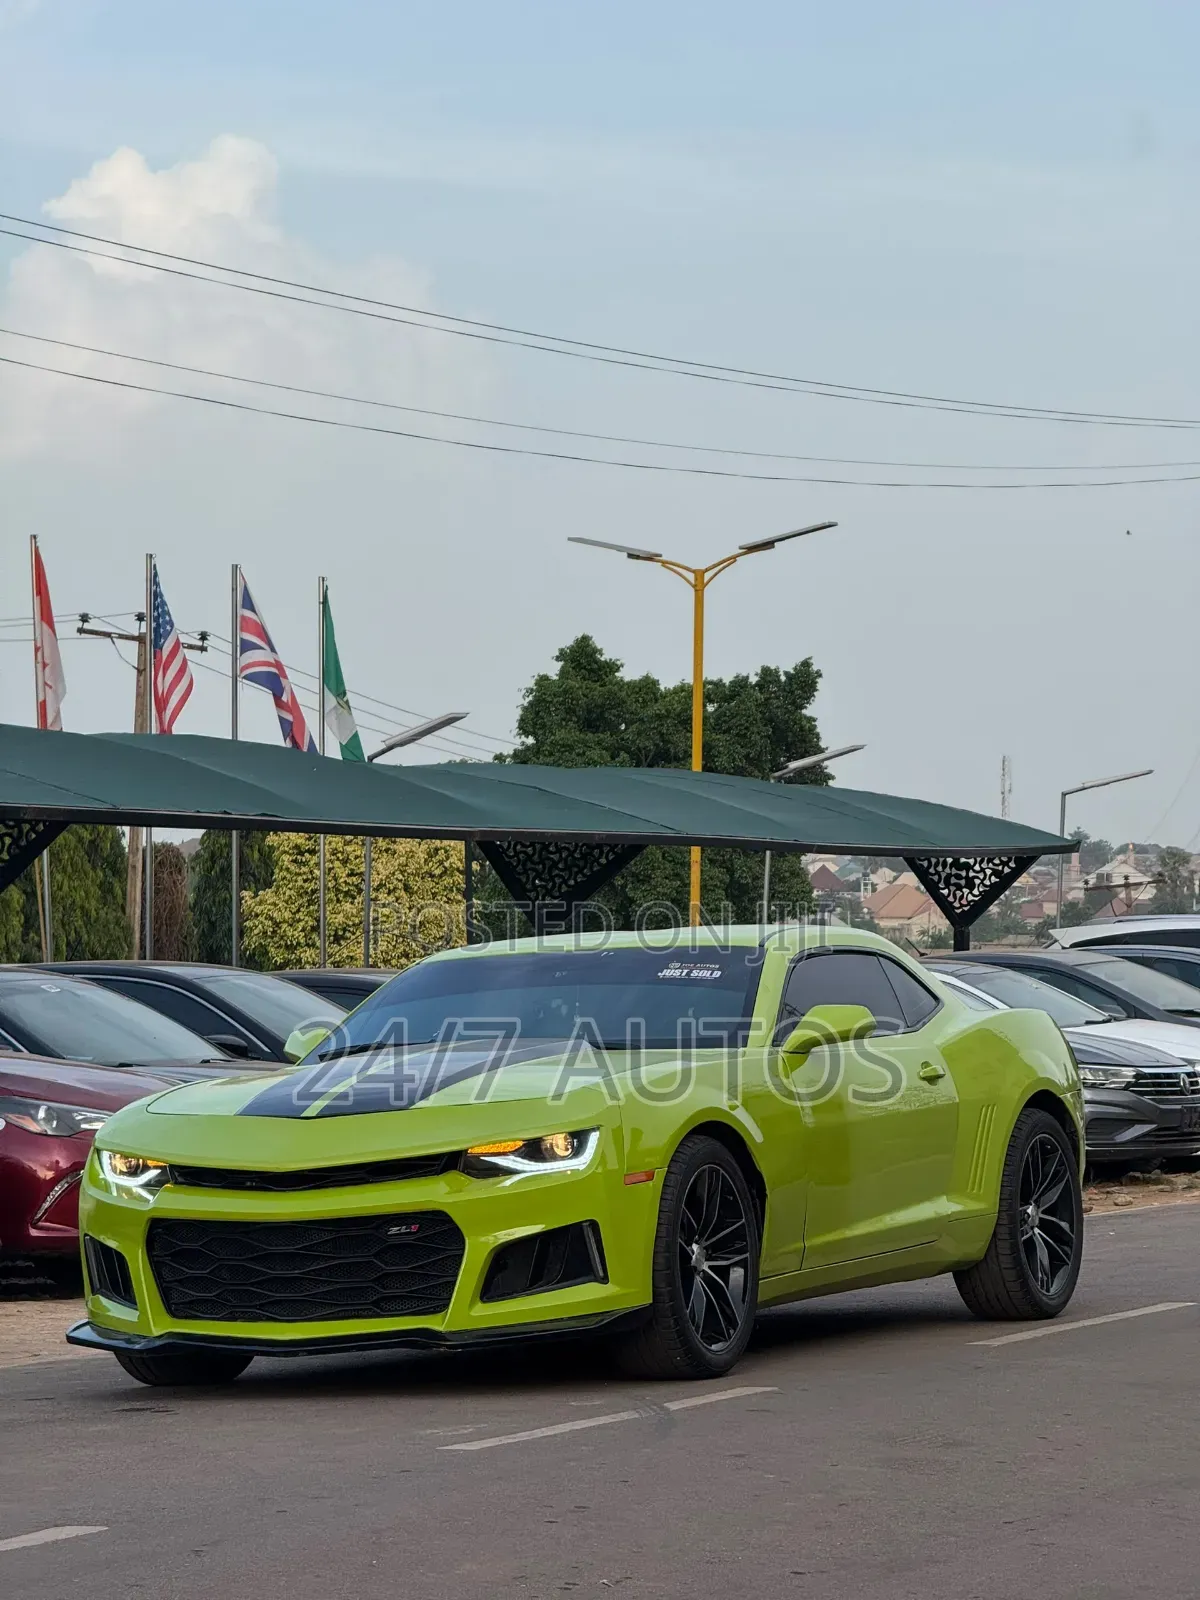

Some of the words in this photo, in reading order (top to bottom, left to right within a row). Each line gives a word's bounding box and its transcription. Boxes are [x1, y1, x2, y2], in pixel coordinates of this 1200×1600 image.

[657, 969, 690, 977] JUST
[690, 969, 722, 978] SOLD
[387, 1225, 419, 1235] ZL1
